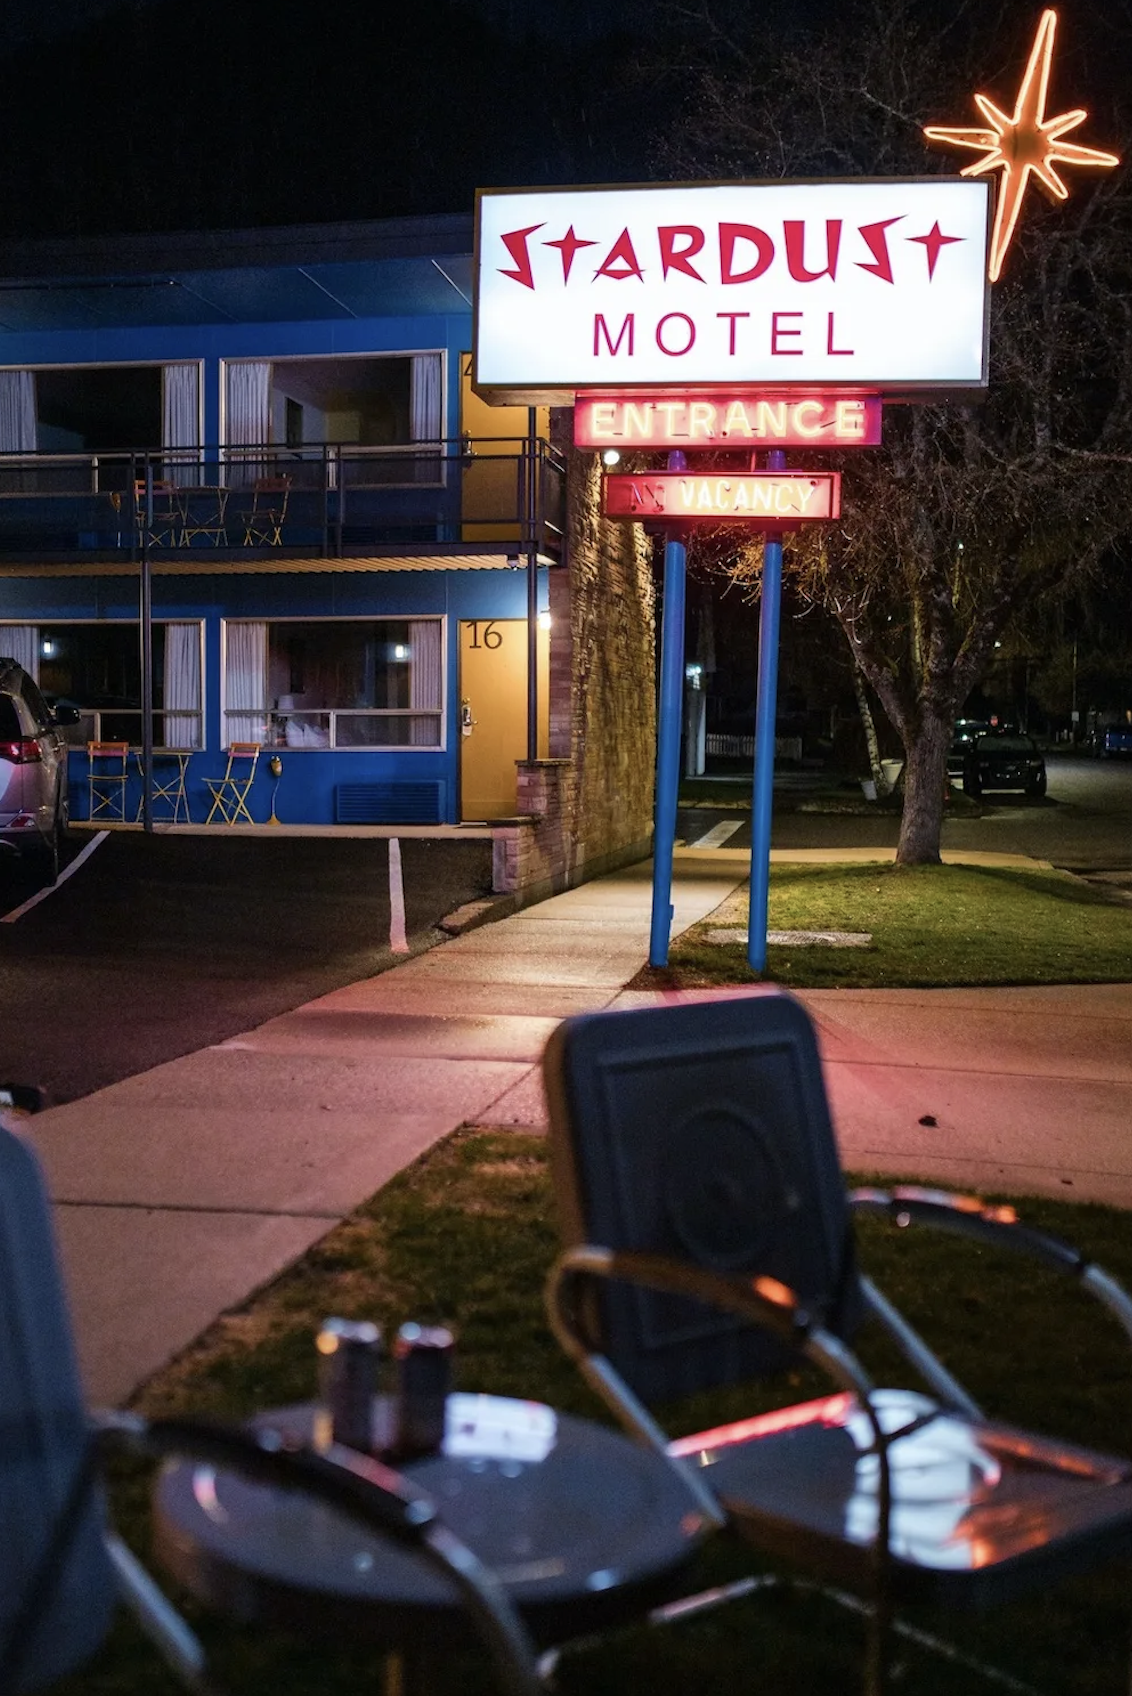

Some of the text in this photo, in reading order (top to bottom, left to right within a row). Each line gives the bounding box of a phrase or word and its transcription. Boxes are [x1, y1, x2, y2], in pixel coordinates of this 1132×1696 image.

[496, 214, 968, 290] STARDUST
[592, 311, 855, 357] MOTEL
[590, 400, 866, 439] ENTRANCE
[680, 479, 817, 512] VACANCY
[466, 621, 503, 649] 16
